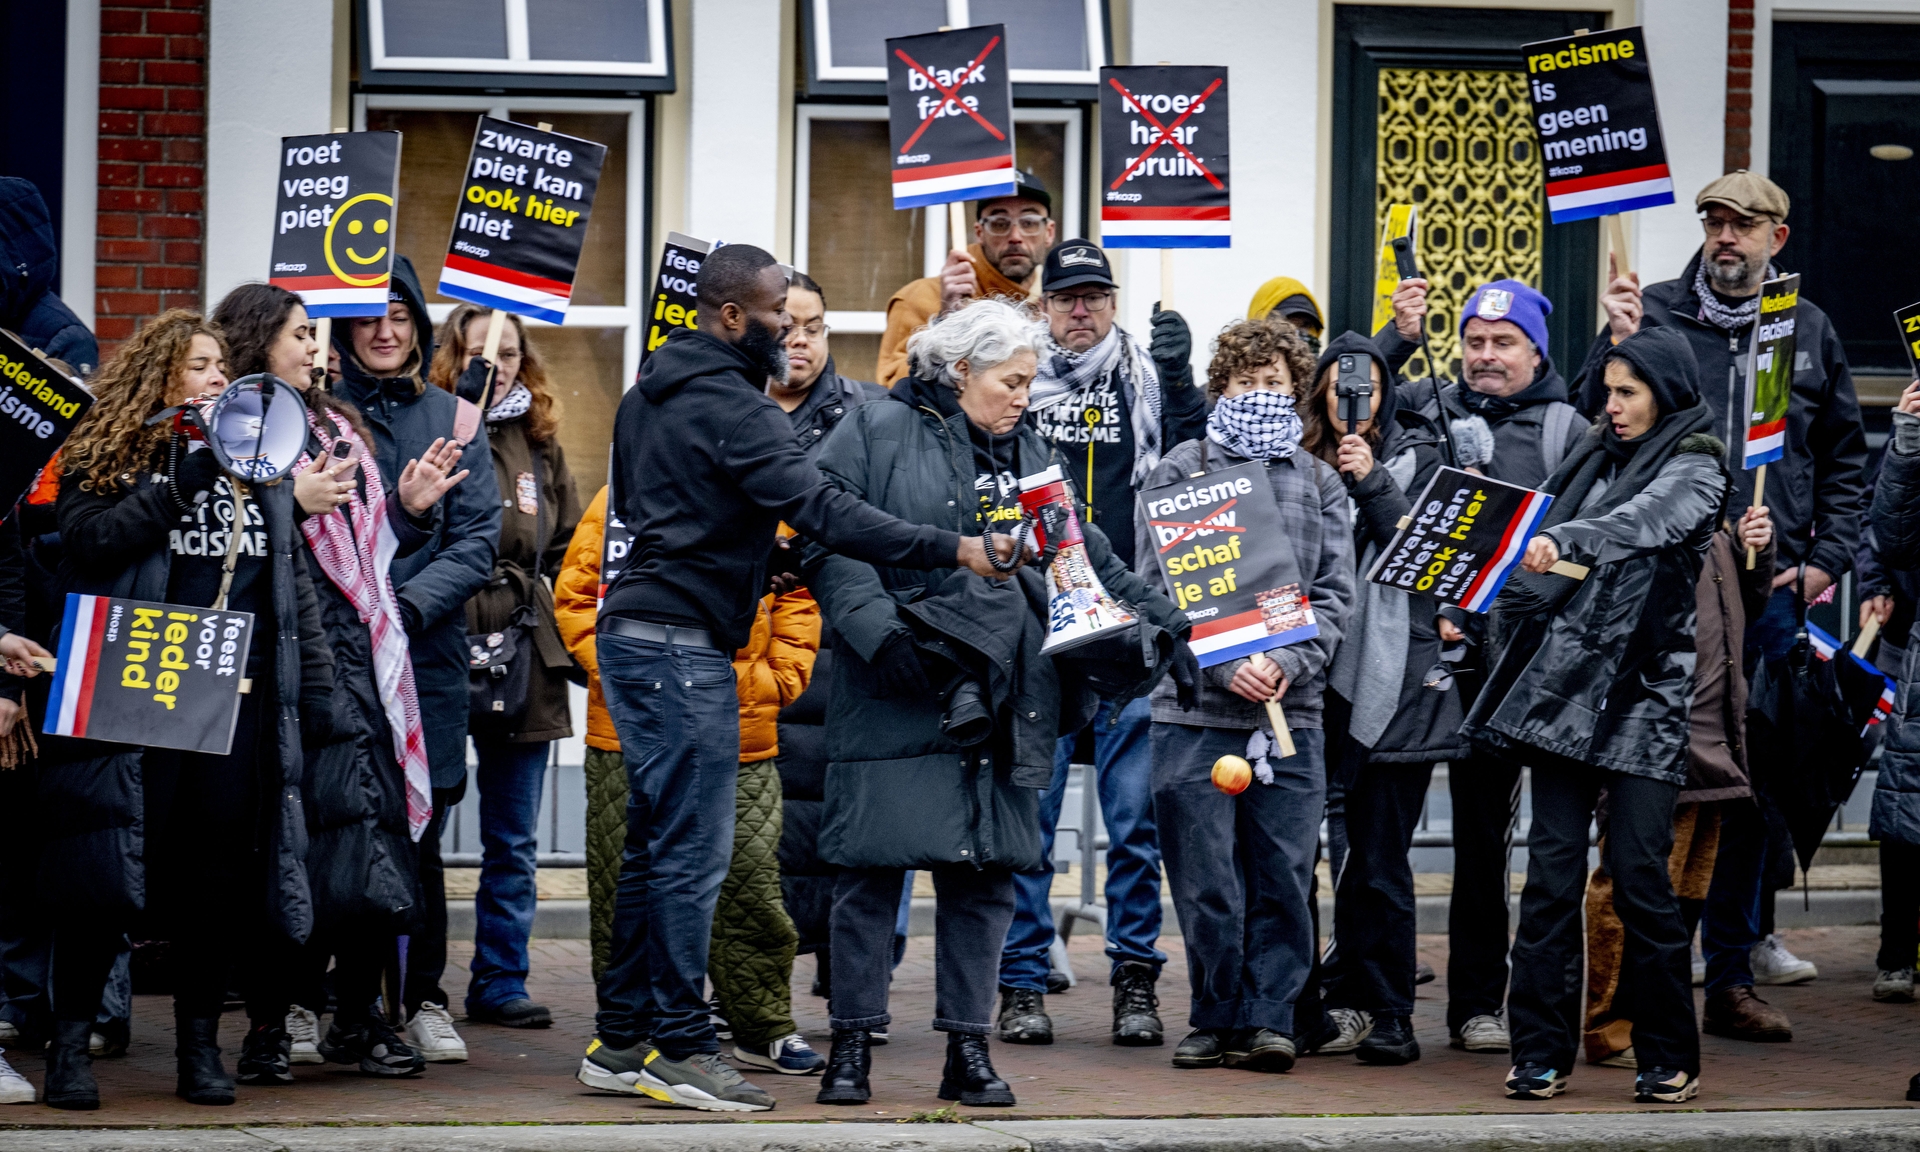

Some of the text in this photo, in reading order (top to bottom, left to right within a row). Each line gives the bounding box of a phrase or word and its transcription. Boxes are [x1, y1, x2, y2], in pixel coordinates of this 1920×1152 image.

[1528, 39, 1635, 74] racisme
[908, 60, 986, 92] black
[1532, 79, 1557, 103] is
[917, 95, 979, 120] face
[1122, 88, 1206, 114] kroes
[1130, 120, 1199, 145] haar
[1538, 103, 1609, 136] geen
[286, 140, 342, 167] roet
[479, 129, 573, 168] zwarte
[897, 153, 931, 165] #kozp
[1543, 127, 1648, 161] mening
[472, 156, 583, 200] piet kan
[1125, 151, 1205, 182] pruik
[1549, 164, 1583, 178] #kozp
[283, 175, 349, 200] veeg
[1106, 191, 1142, 203] #kozp
[280, 204, 334, 235] piet
[466, 185, 580, 228] ook hier
[459, 211, 514, 241] niet
[454, 240, 490, 258] #kozp
[274, 262, 307, 273] #kozp
[1758, 317, 1796, 343] racisme
[0, 385, 55, 439] isme
[1147, 477, 1253, 519] racisme
[1154, 510, 1236, 547] bouw
[1379, 499, 1443, 583] zwarte
[1396, 488, 1471, 587] piet kan
[1416, 489, 1488, 591] ook hier
[1166, 535, 1241, 576] schaf
[1173, 567, 1237, 610] je af
[1434, 551, 1476, 597] niet
[1453, 569, 1479, 600] #kozp
[106, 605, 124, 643] #kozp
[120, 607, 164, 689] kind
[194, 614, 220, 671] voor
[216, 617, 246, 676] feest
[153, 612, 198, 710] ieder
